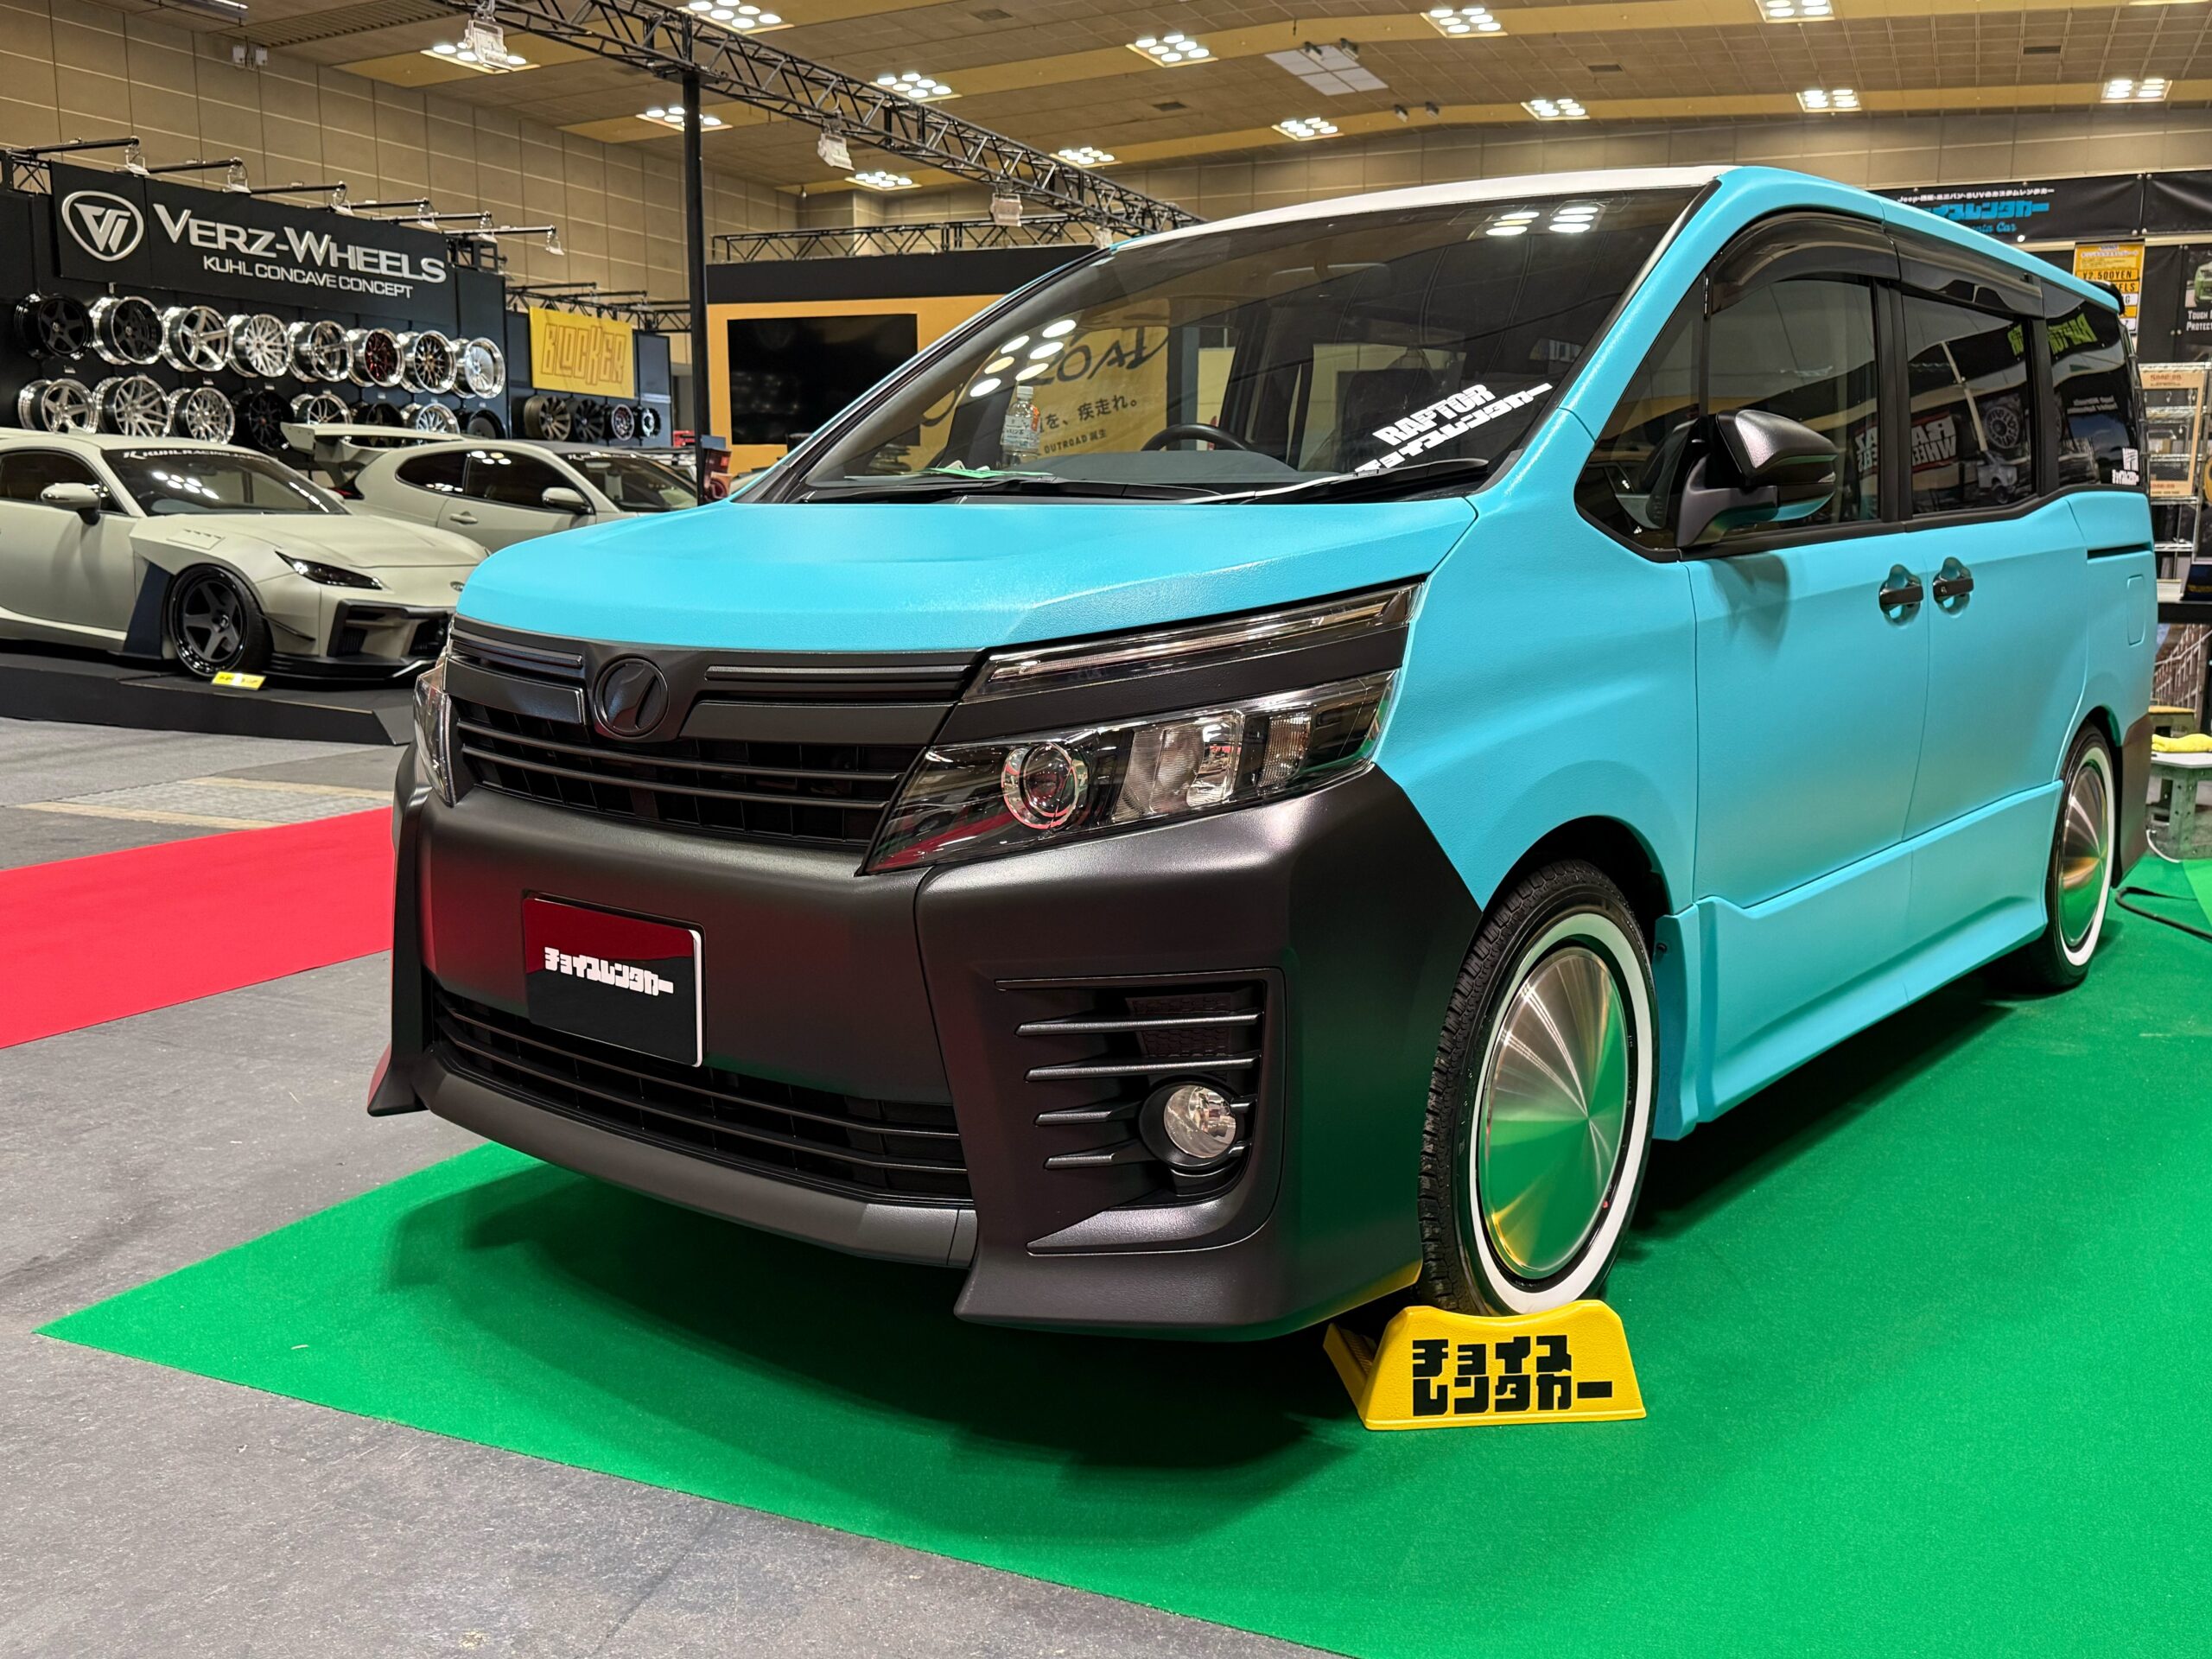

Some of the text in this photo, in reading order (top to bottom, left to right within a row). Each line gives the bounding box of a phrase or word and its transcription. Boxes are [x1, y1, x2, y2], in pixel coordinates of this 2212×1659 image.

[153, 203, 448, 283] VERZ-WHEELS
[203, 255, 413, 299] KUHL CONCAVE CONCEPT
[542, 323, 626, 386] BLOCKER
[1039, 395, 1138, 433] を、疾走れ。
[1372, 384, 1496, 446] RAPTOR
[1044, 435, 1089, 454] OUTROAD
[544, 946, 674, 996] チョイスレンタカー
[1412, 1335, 1573, 1377] チョイス
[1412, 1373, 1613, 1417] レンタカー
